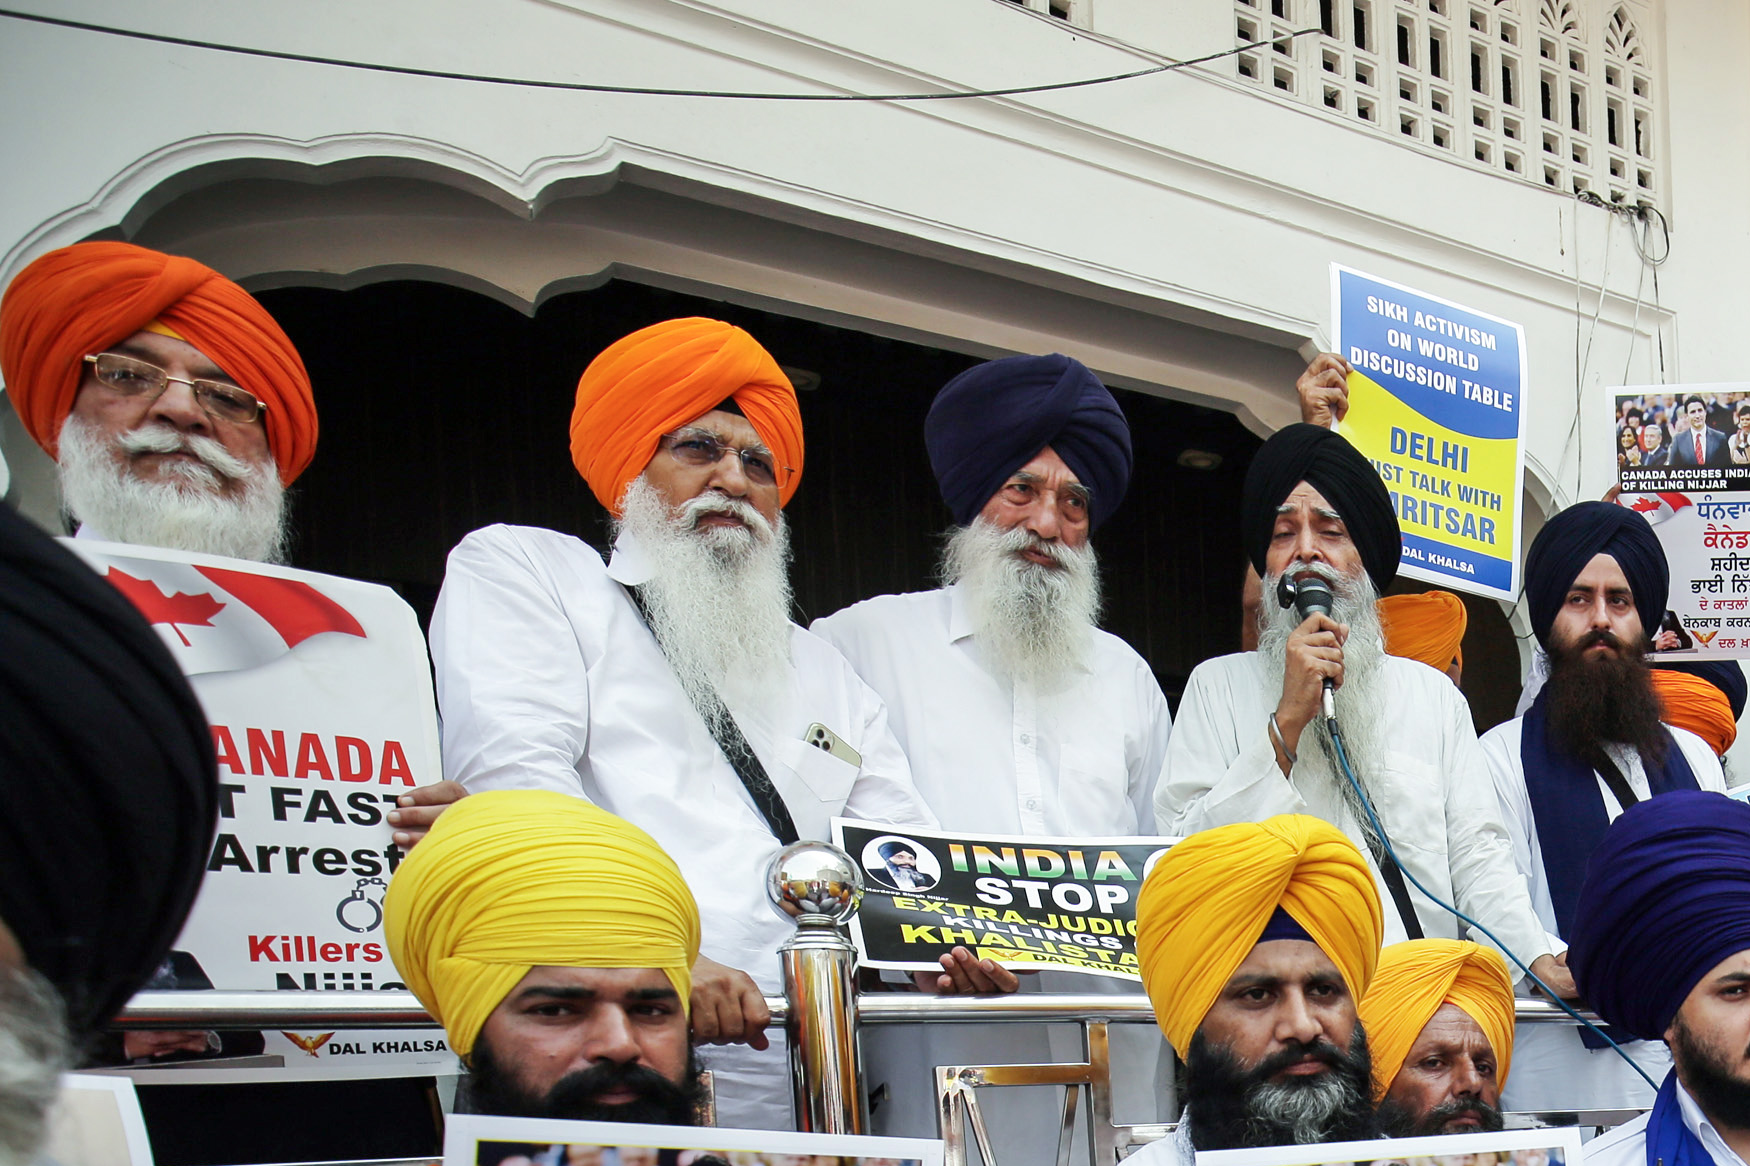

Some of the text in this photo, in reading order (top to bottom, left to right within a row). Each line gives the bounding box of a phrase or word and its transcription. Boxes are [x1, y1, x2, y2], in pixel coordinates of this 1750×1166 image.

[1367, 295, 1496, 351] SIKH ACTIVISM
[1387, 329, 1479, 371] ON WORLD
[1351, 346, 1513, 412] DISCUSSION TABLE
[1390, 427, 1469, 473] DELHI
[1410, 470, 1501, 512] TALK WITH
[1622, 470, 1666, 480] CANADA
[1670, 469, 1722, 479] ACCUSES
[1622, 479, 1727, 490] OF KILLING NIJJAR
[1402, 545, 1475, 574] DAL KHALSA
[1711, 553, 1750, 572] ਸ਼ਹੀਦ
[1691, 578, 1724, 593] ਭਾਈ
[209, 725, 416, 786] ANADA
[949, 844, 1137, 881] INDIA
[975, 877, 1129, 914] STOP
[248, 935, 383, 962] Killers
[943, 915, 1123, 950] KILLINGS
[1033, 954, 1075, 966] DAL
[329, 1039, 447, 1054] DAL KHALSA
